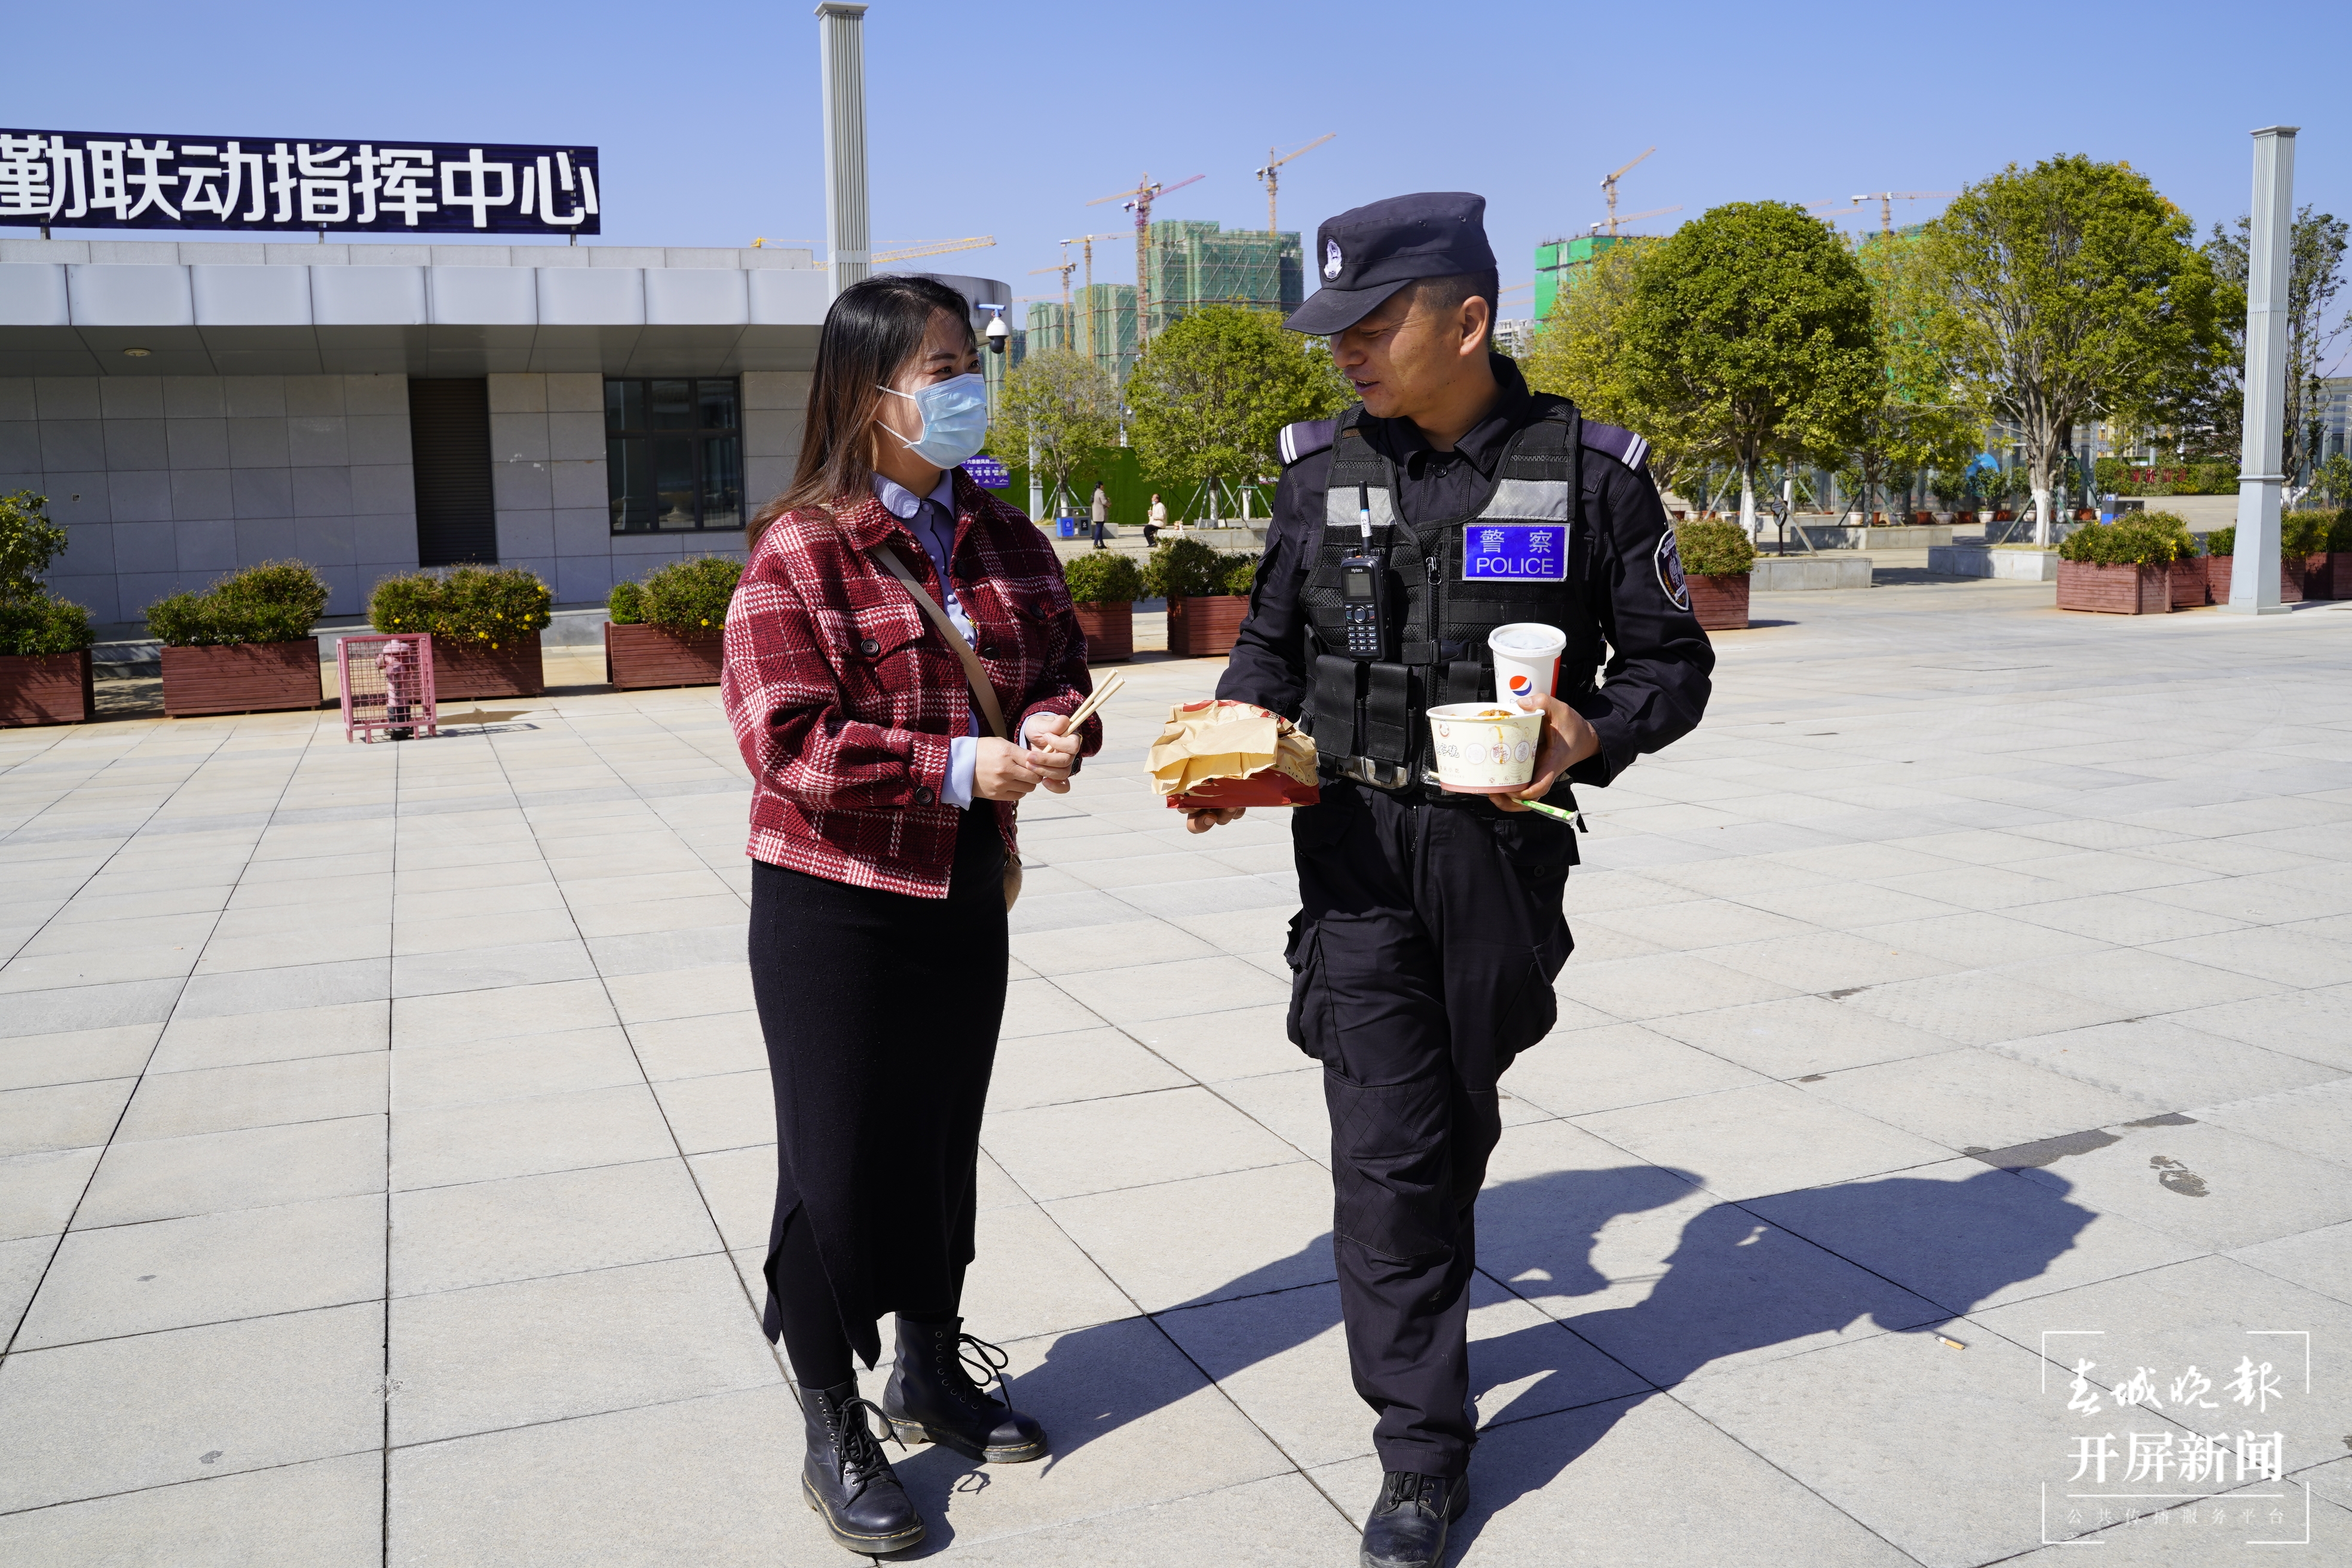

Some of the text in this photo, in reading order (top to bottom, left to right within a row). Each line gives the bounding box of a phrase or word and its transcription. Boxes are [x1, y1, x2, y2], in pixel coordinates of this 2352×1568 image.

[0, 134, 598, 228] 勤联动指挥中心
[1480, 529, 1552, 553] 警察
[1476, 557, 1554, 574] POLICE
